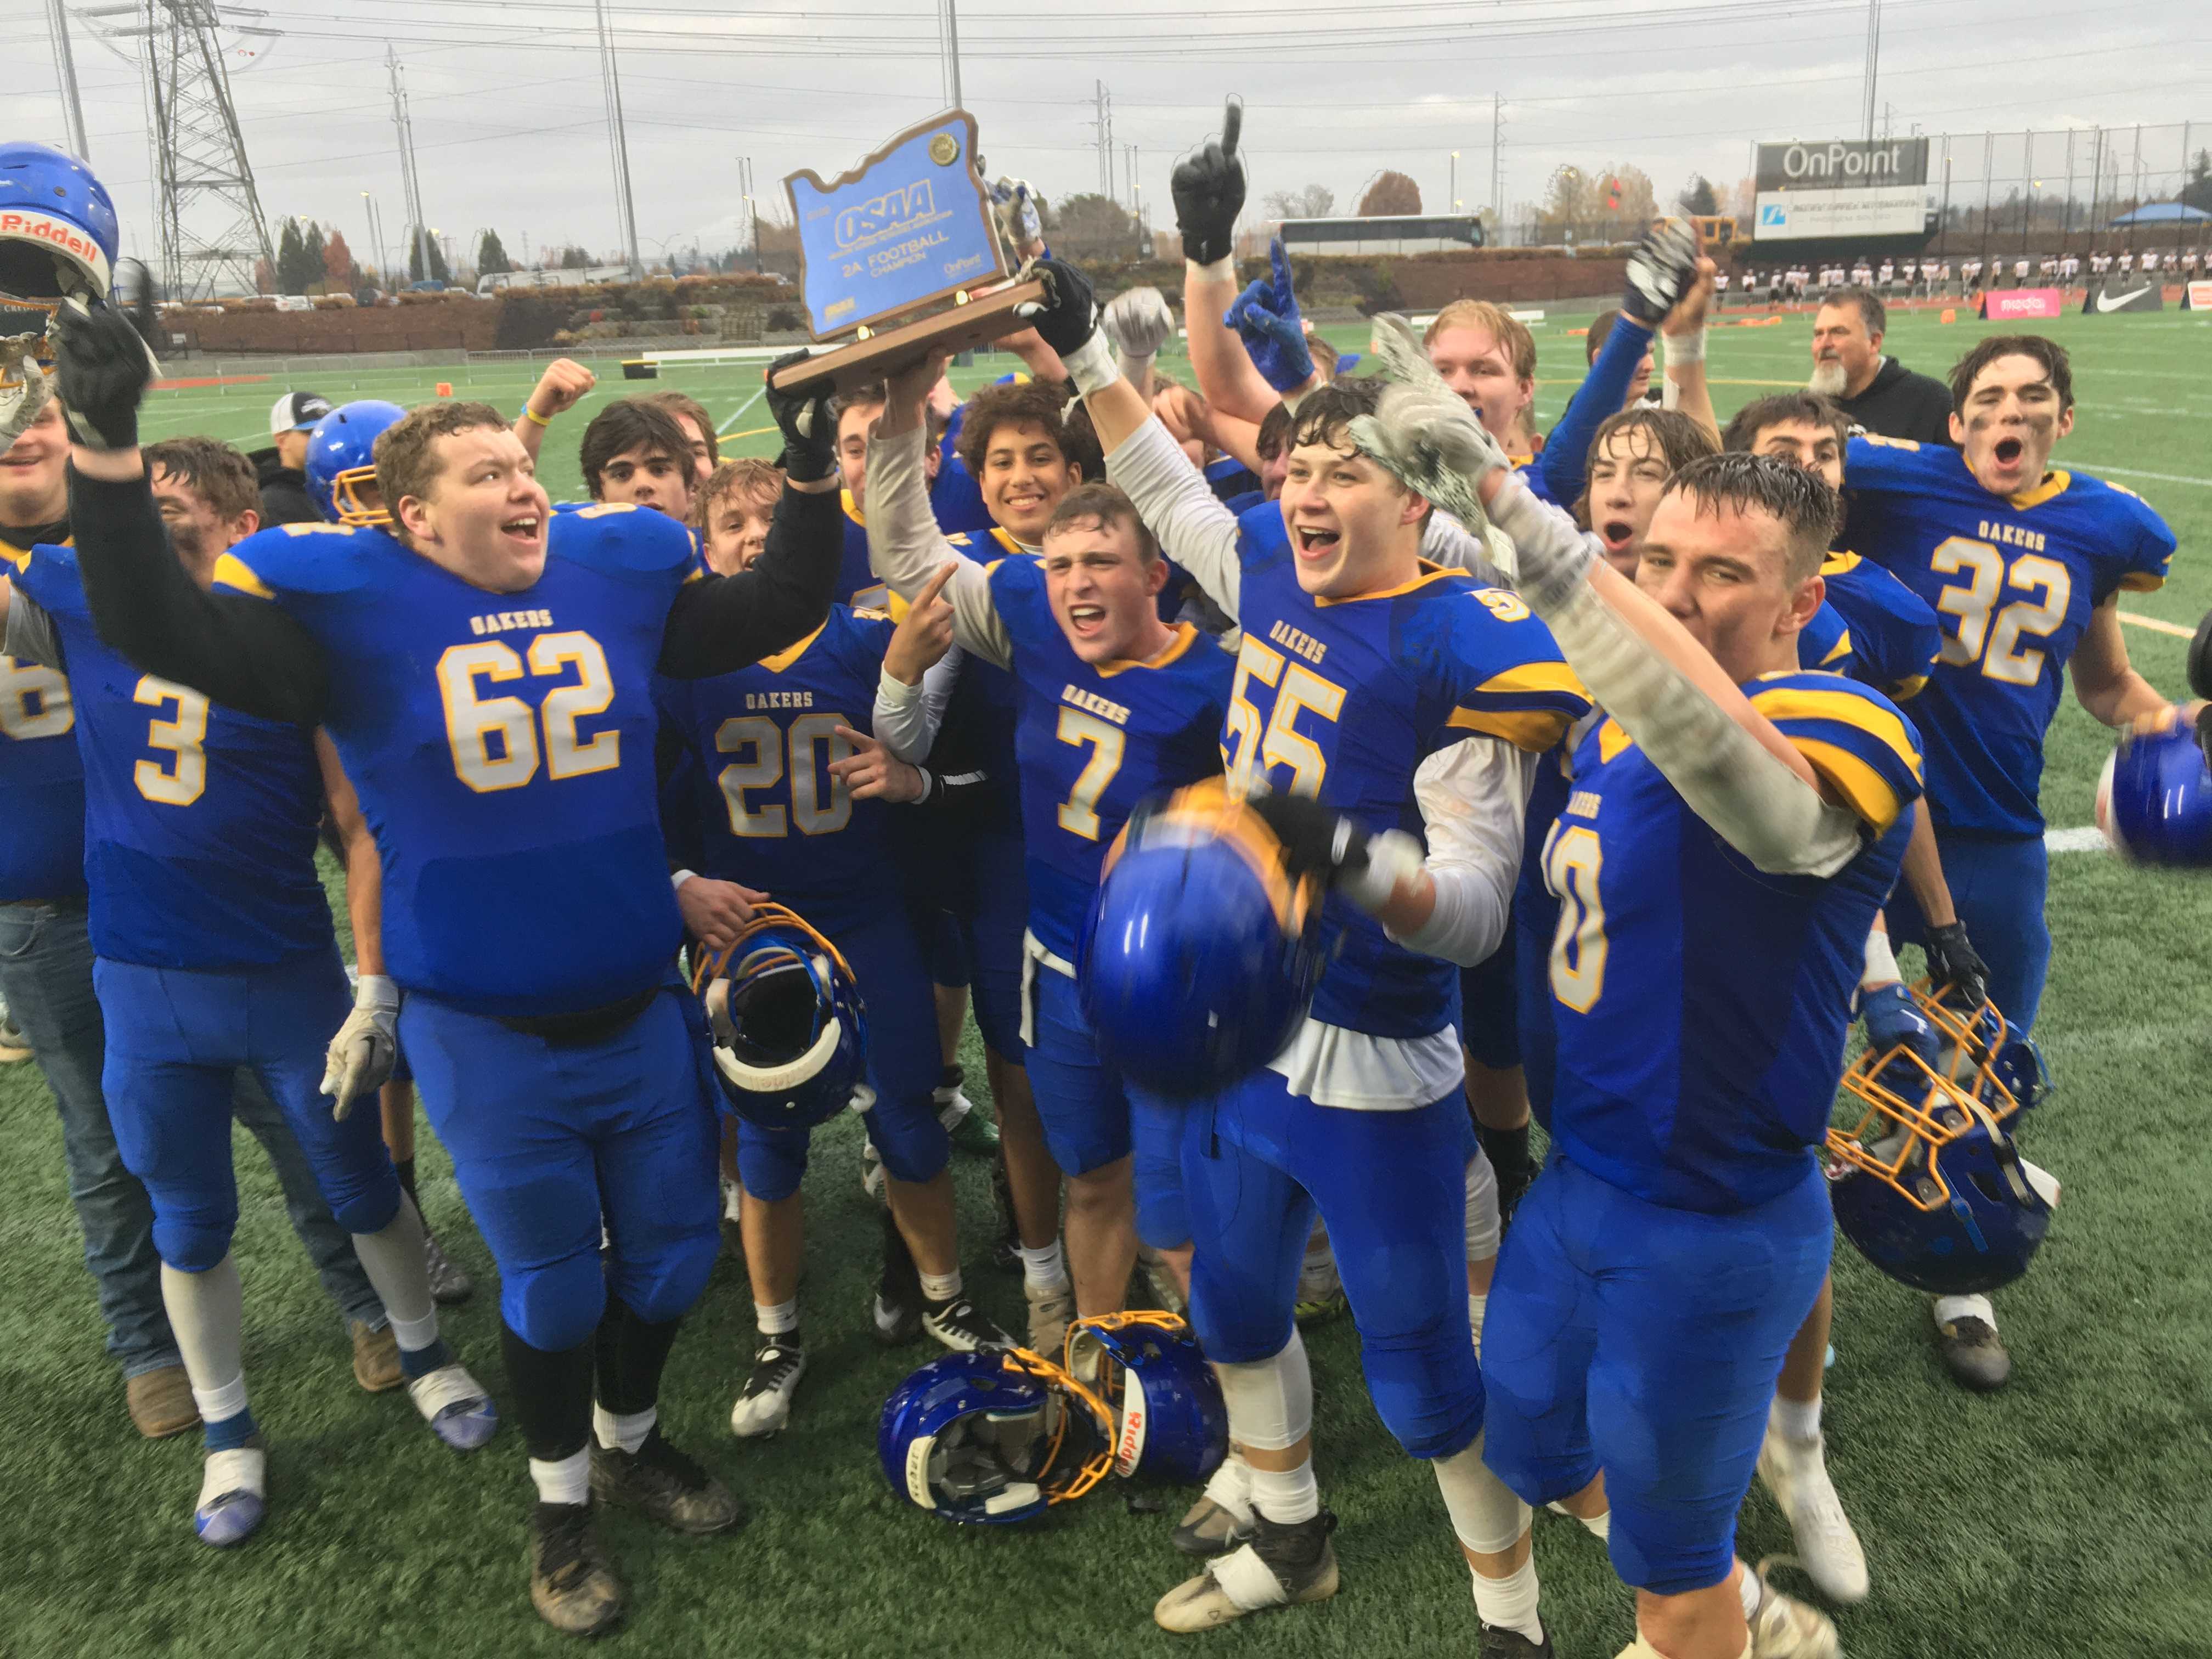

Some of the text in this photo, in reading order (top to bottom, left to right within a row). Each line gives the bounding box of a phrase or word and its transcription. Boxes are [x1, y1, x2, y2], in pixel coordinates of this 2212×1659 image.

[1783, 144, 1900, 178] OnPoint
[835, 178, 936, 248] OSAA
[1, 215, 97, 263] Riddell
[842, 262, 864, 278] 2A
[868, 230, 949, 267] FOOTBALL
[870, 251, 927, 278] CHAMPION
[944, 254, 981, 274] OnPoint
[1979, 521, 2045, 552] OAKERS
[470, 609, 554, 635] OAKERS
[1931, 535, 2071, 686] 32
[1269, 619, 1327, 664] OAKERS
[436, 630, 620, 793] 62
[746, 692, 813, 709] OAKERS
[1060, 684, 1132, 725] OAKERS
[1220, 632, 1347, 805] 55
[134, 673, 210, 806] 3
[715, 713, 853, 837] 20
[1056, 705, 1127, 842] 7
[1541, 818, 1609, 1015] 0
[1115, 1411, 1142, 1475] Riddell
